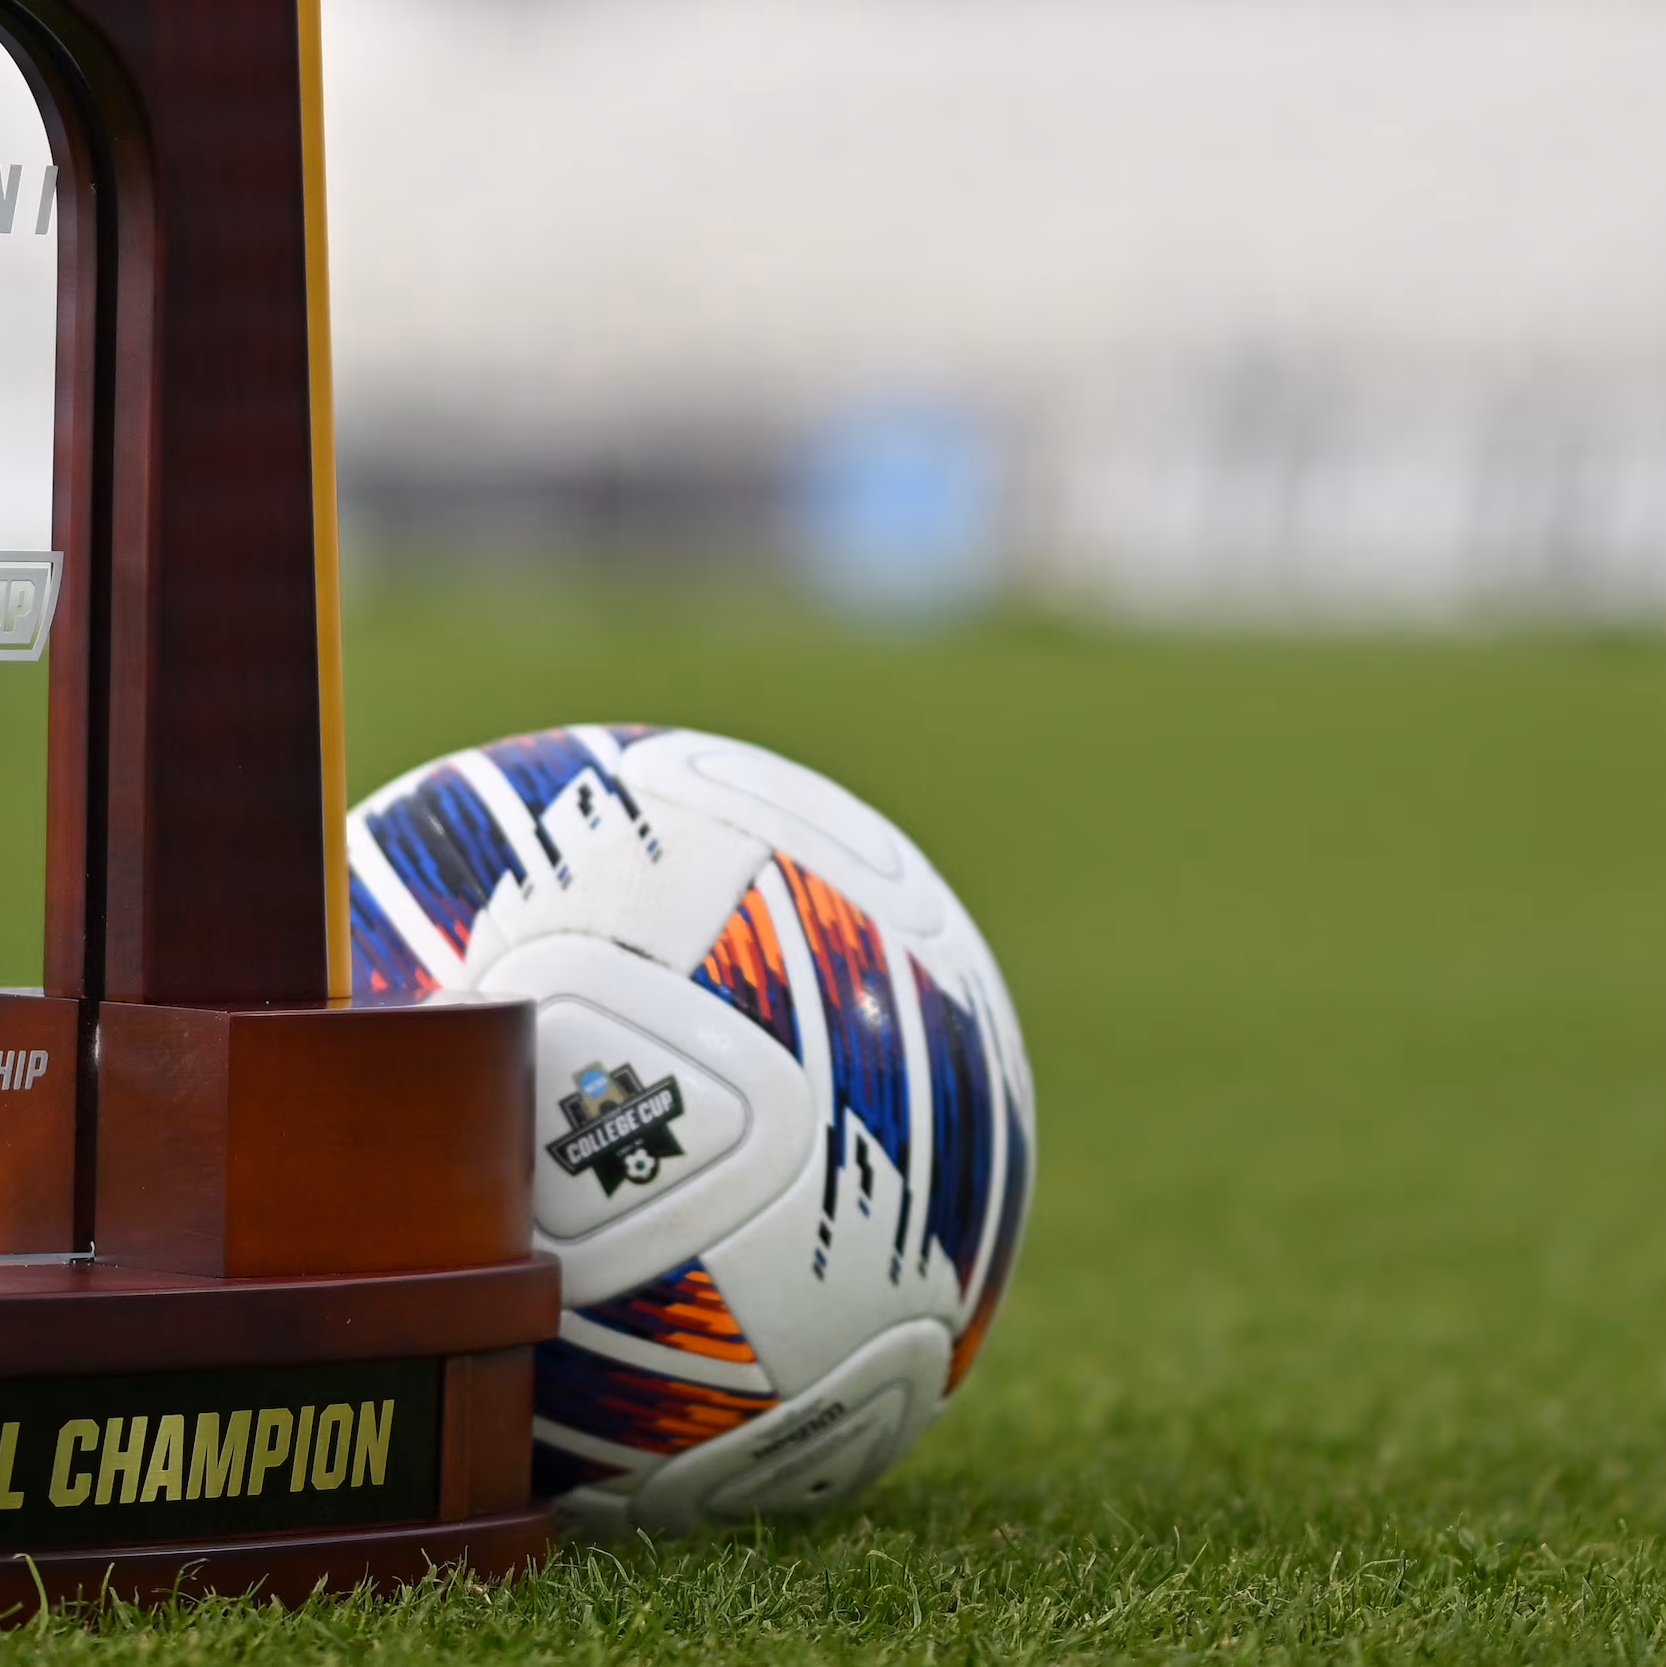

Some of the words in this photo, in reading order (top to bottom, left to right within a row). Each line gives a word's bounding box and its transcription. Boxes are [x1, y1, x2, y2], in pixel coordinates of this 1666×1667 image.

[34, 165, 59, 235] I
[566, 1109, 640, 1165] COLLEGE
[637, 1089, 675, 1124] CUP
[48, 1398, 396, 1508] CHAMPION
